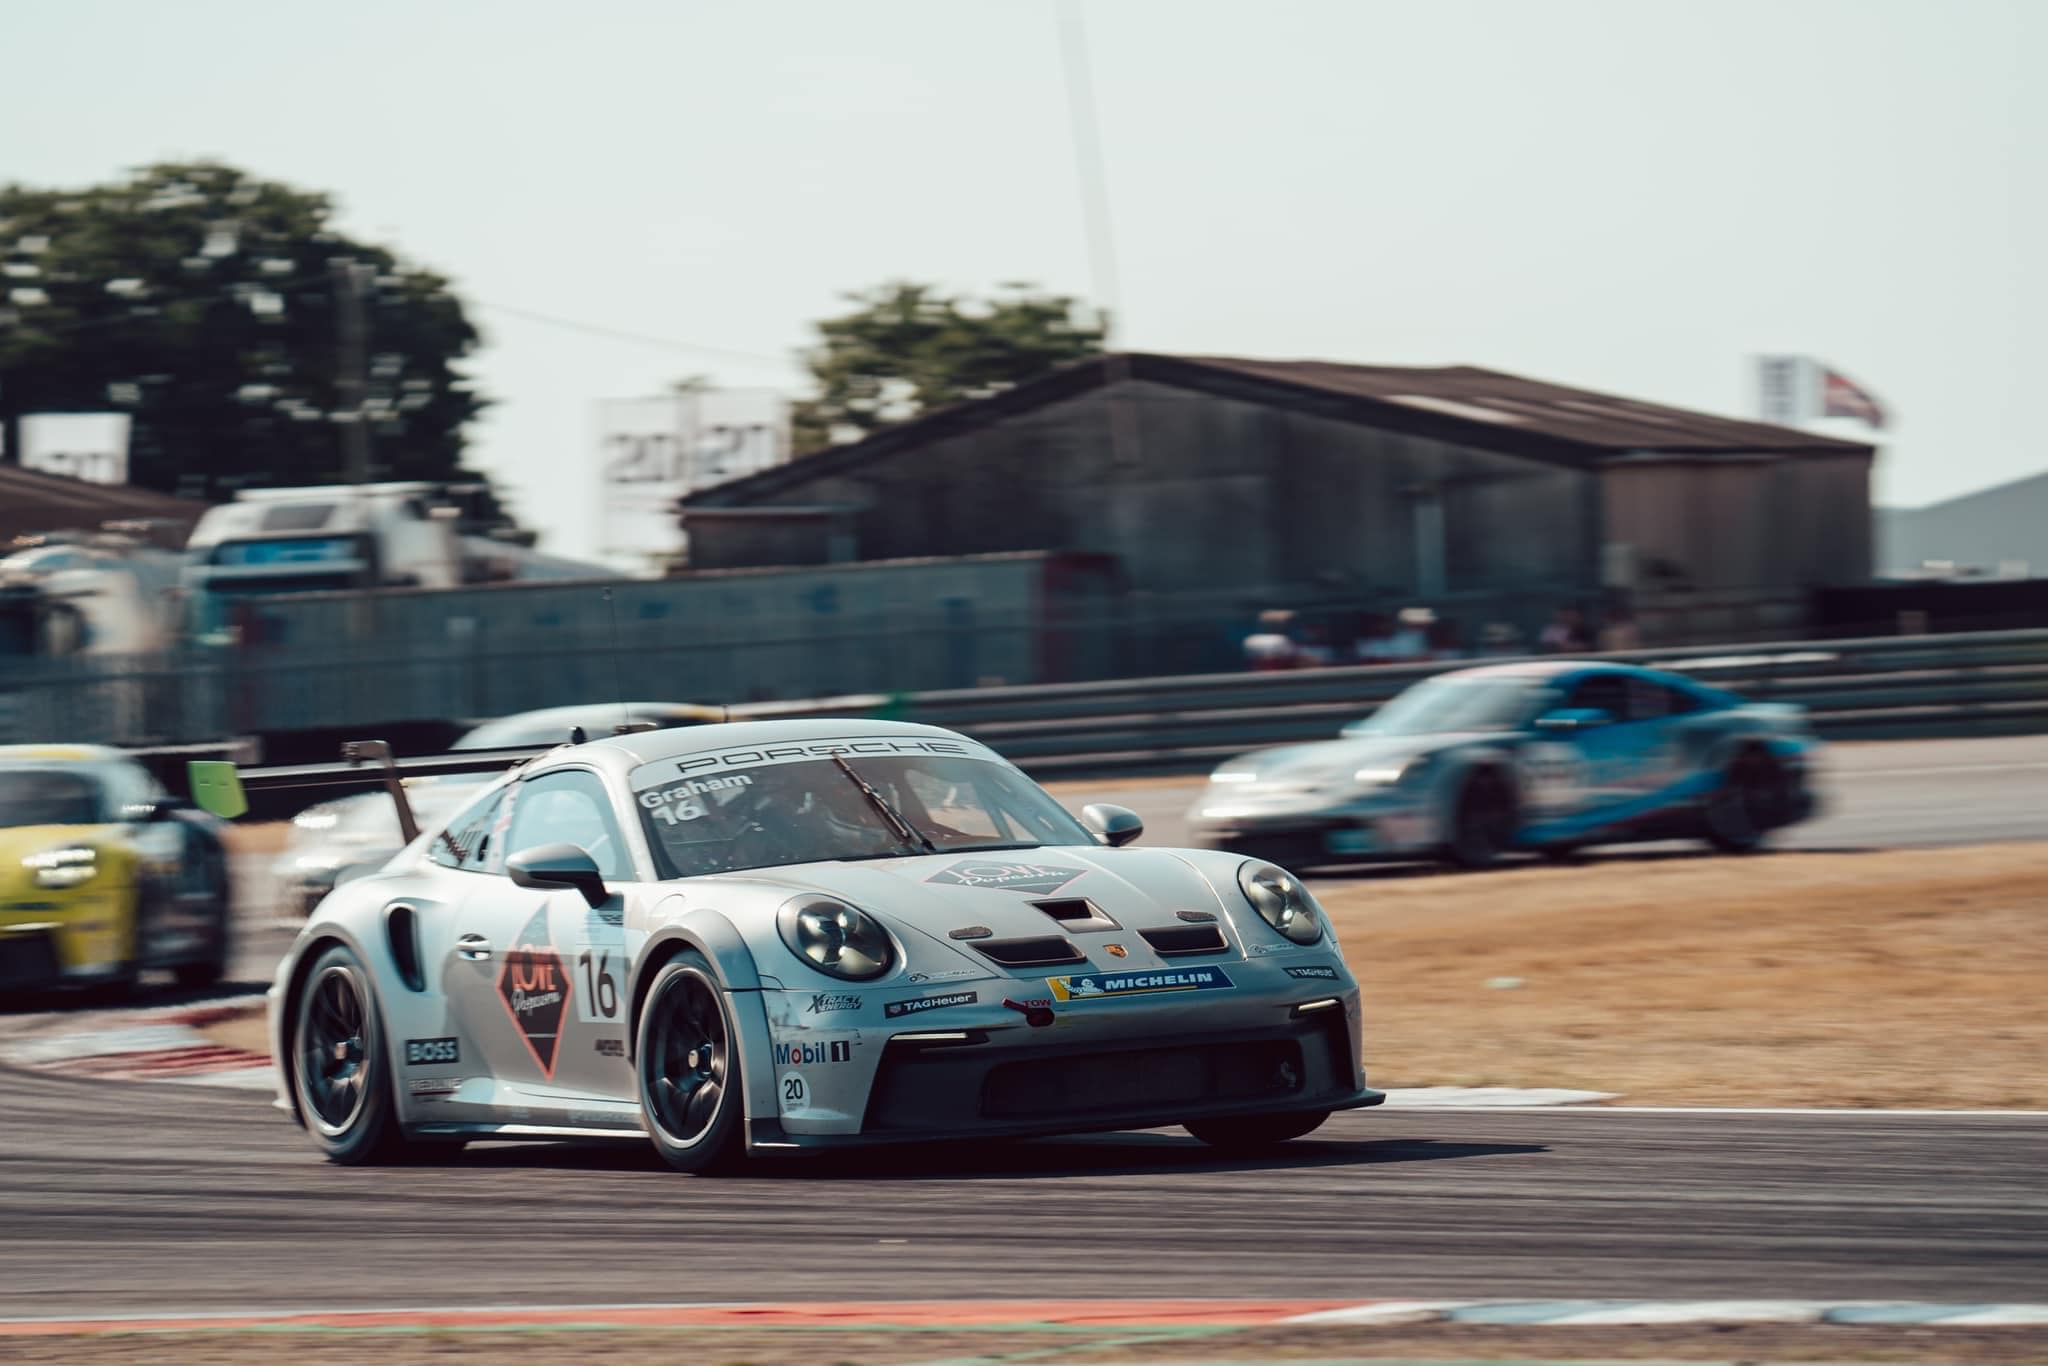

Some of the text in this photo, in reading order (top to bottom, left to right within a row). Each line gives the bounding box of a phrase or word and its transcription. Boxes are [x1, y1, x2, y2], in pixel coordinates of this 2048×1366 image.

[677, 742, 968, 773] PORSCHE
[639, 775, 753, 808] Graham
[652, 800, 702, 825] 16
[580, 949, 617, 1018] 16
[1105, 972, 1213, 990] MICHELIN
[409, 1041, 457, 1061] BOSS
[776, 1041, 846, 1065] Mobil 1
[784, 1078, 804, 1100] 20
